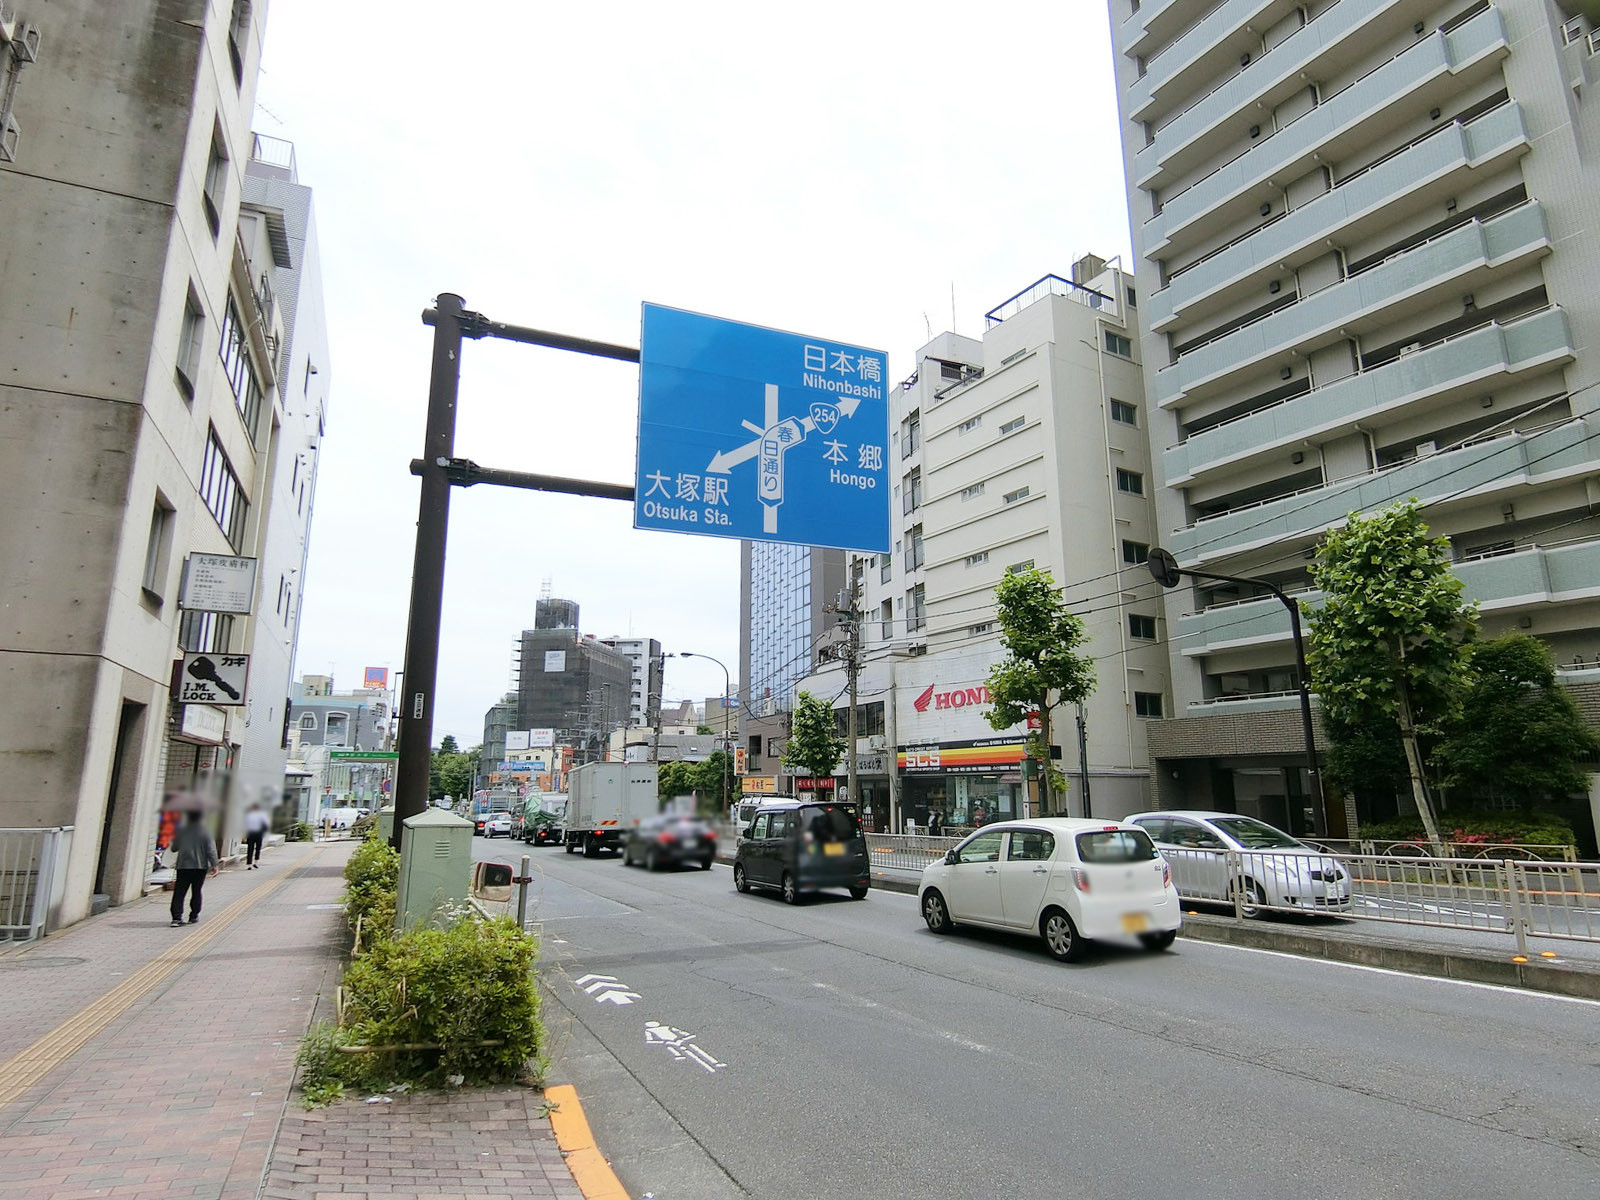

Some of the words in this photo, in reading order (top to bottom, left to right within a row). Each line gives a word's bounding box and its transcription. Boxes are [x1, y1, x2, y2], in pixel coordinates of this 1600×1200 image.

[804, 344, 881, 383] 日本橋
[803, 372, 881, 399] Nihonbashi
[814, 407, 836, 424] 254
[763, 426, 794, 492] 春日通り
[822, 439, 882, 471] 本郷
[644, 470, 729, 506] 大塚駅
[830, 469, 876, 489] Hongo
[643, 501, 698, 522] Otsuka
[704, 509, 732, 526] Sta.
[198, 557, 249, 569] 大塚皮膚科
[221, 657, 245, 667] カギ
[182, 692, 216, 701] LOCK
[184, 683, 210, 692] J.M.
[906, 751, 940, 767] SCS
